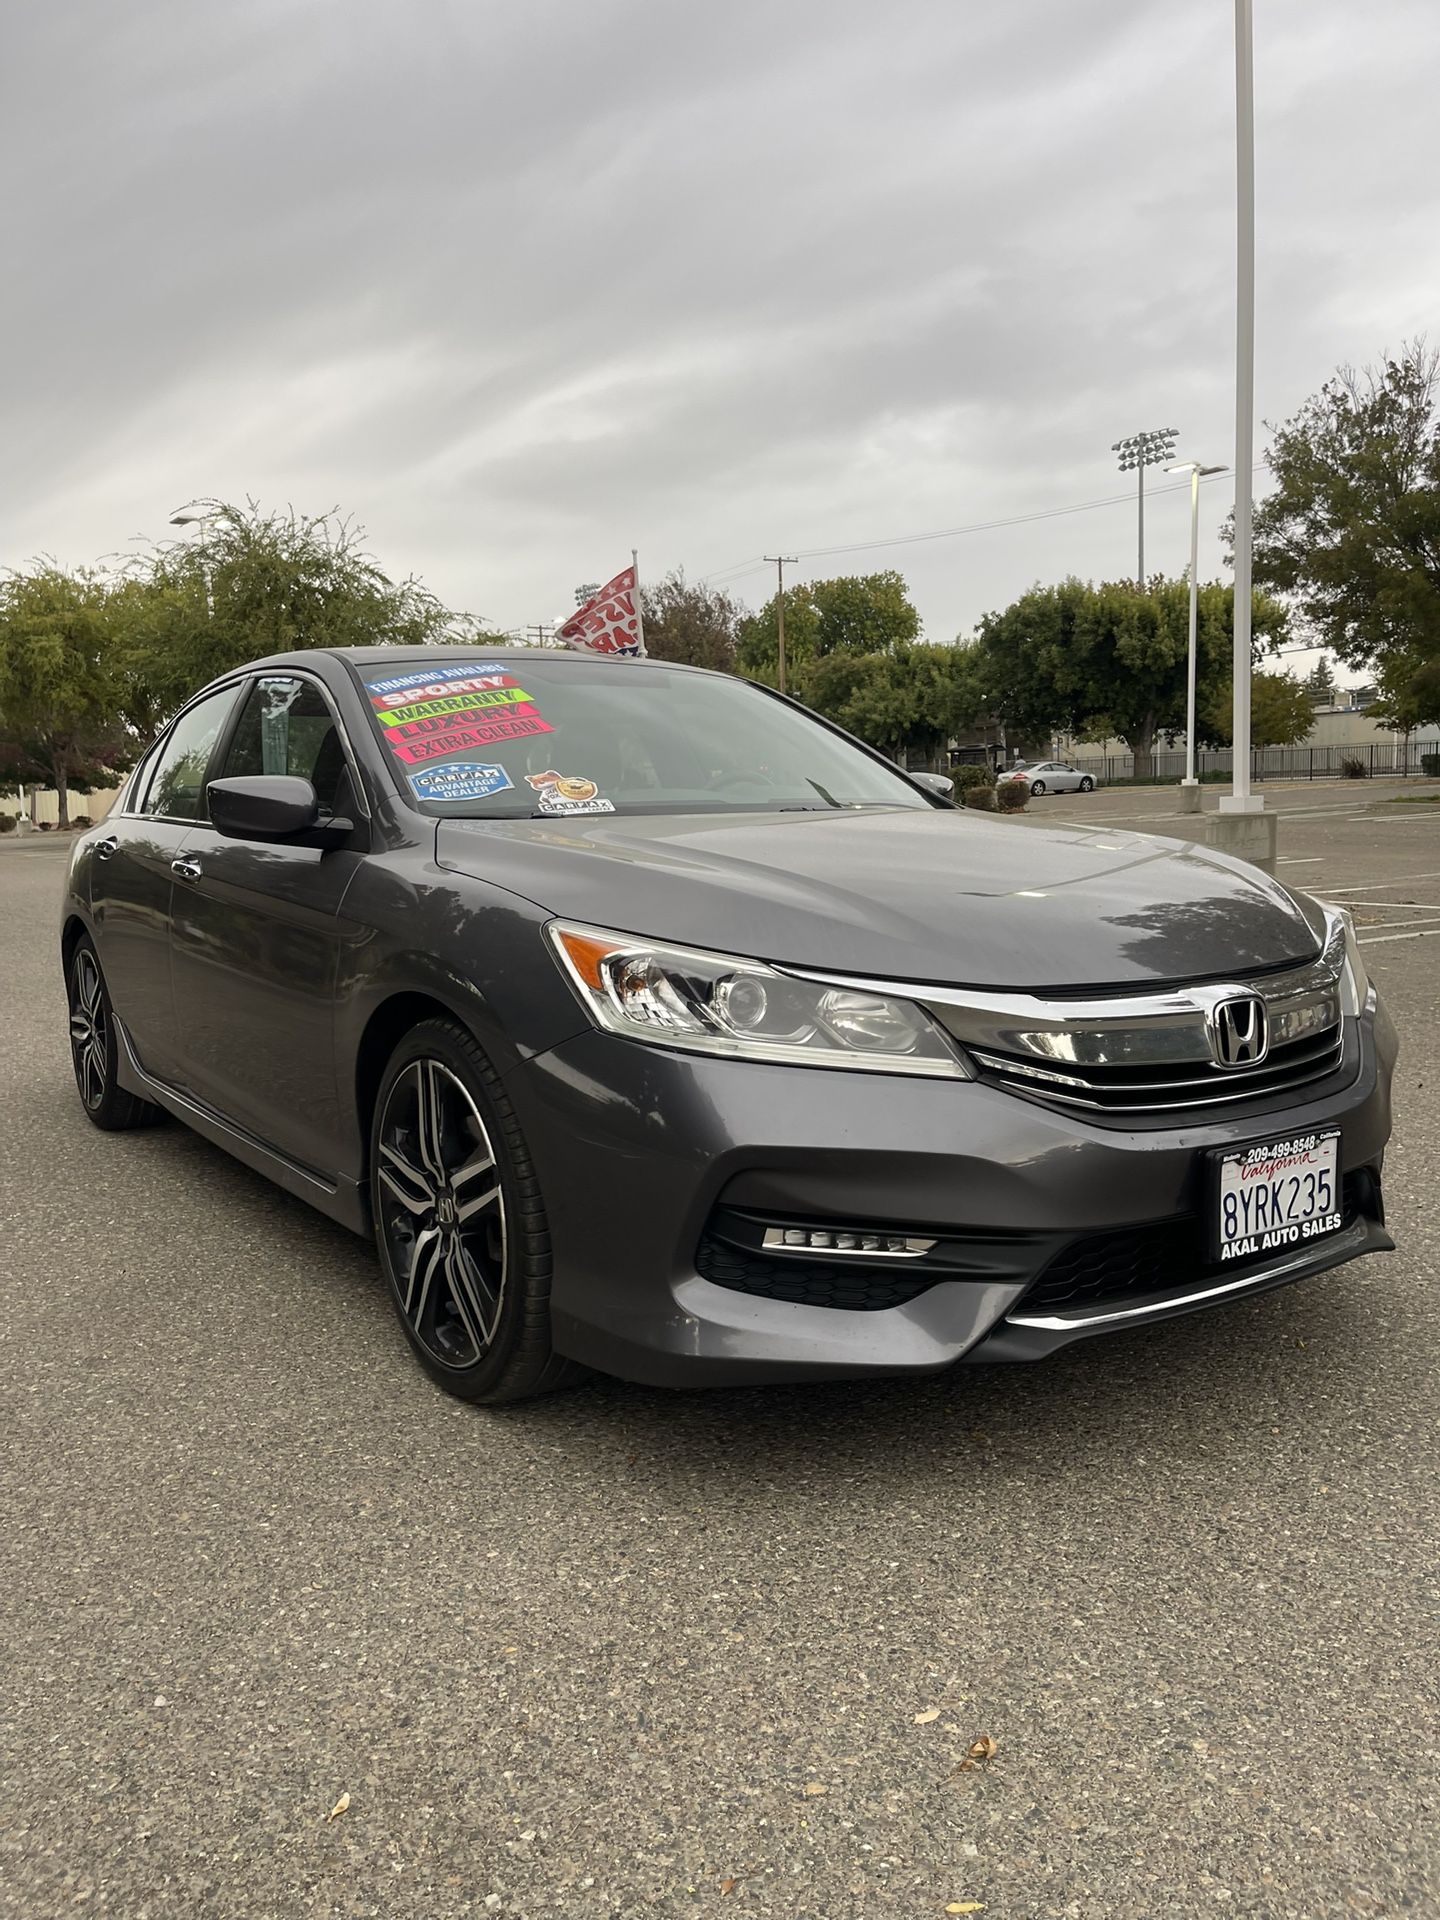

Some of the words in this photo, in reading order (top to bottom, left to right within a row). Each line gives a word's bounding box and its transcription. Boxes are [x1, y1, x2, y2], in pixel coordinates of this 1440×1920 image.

[370, 672, 443, 693] FINANCING
[442, 664, 509, 677] AVAILABLE
[381, 676, 505, 706] SPORTY
[391, 690, 514, 721] WARRANTY
[398, 704, 521, 739] LUXURY
[408, 732, 479, 759] EXTRA
[476, 719, 538, 741] CLEAN
[418, 769, 499, 786] CARFAX
[429, 778, 498, 793] ADVANTAGE
[443, 786, 490, 798] DEALER
[542, 800, 609, 812] CARFAX
[1248, 1135, 1315, 1163] 209-499-8548
[1241, 1151, 1318, 1181] California
[1223, 1168, 1331, 1239] 8YRK235
[1221, 1237, 1259, 1260] AKAL
[1262, 1225, 1299, 1249] AUTO
[1302, 1213, 1342, 1238] SALES
